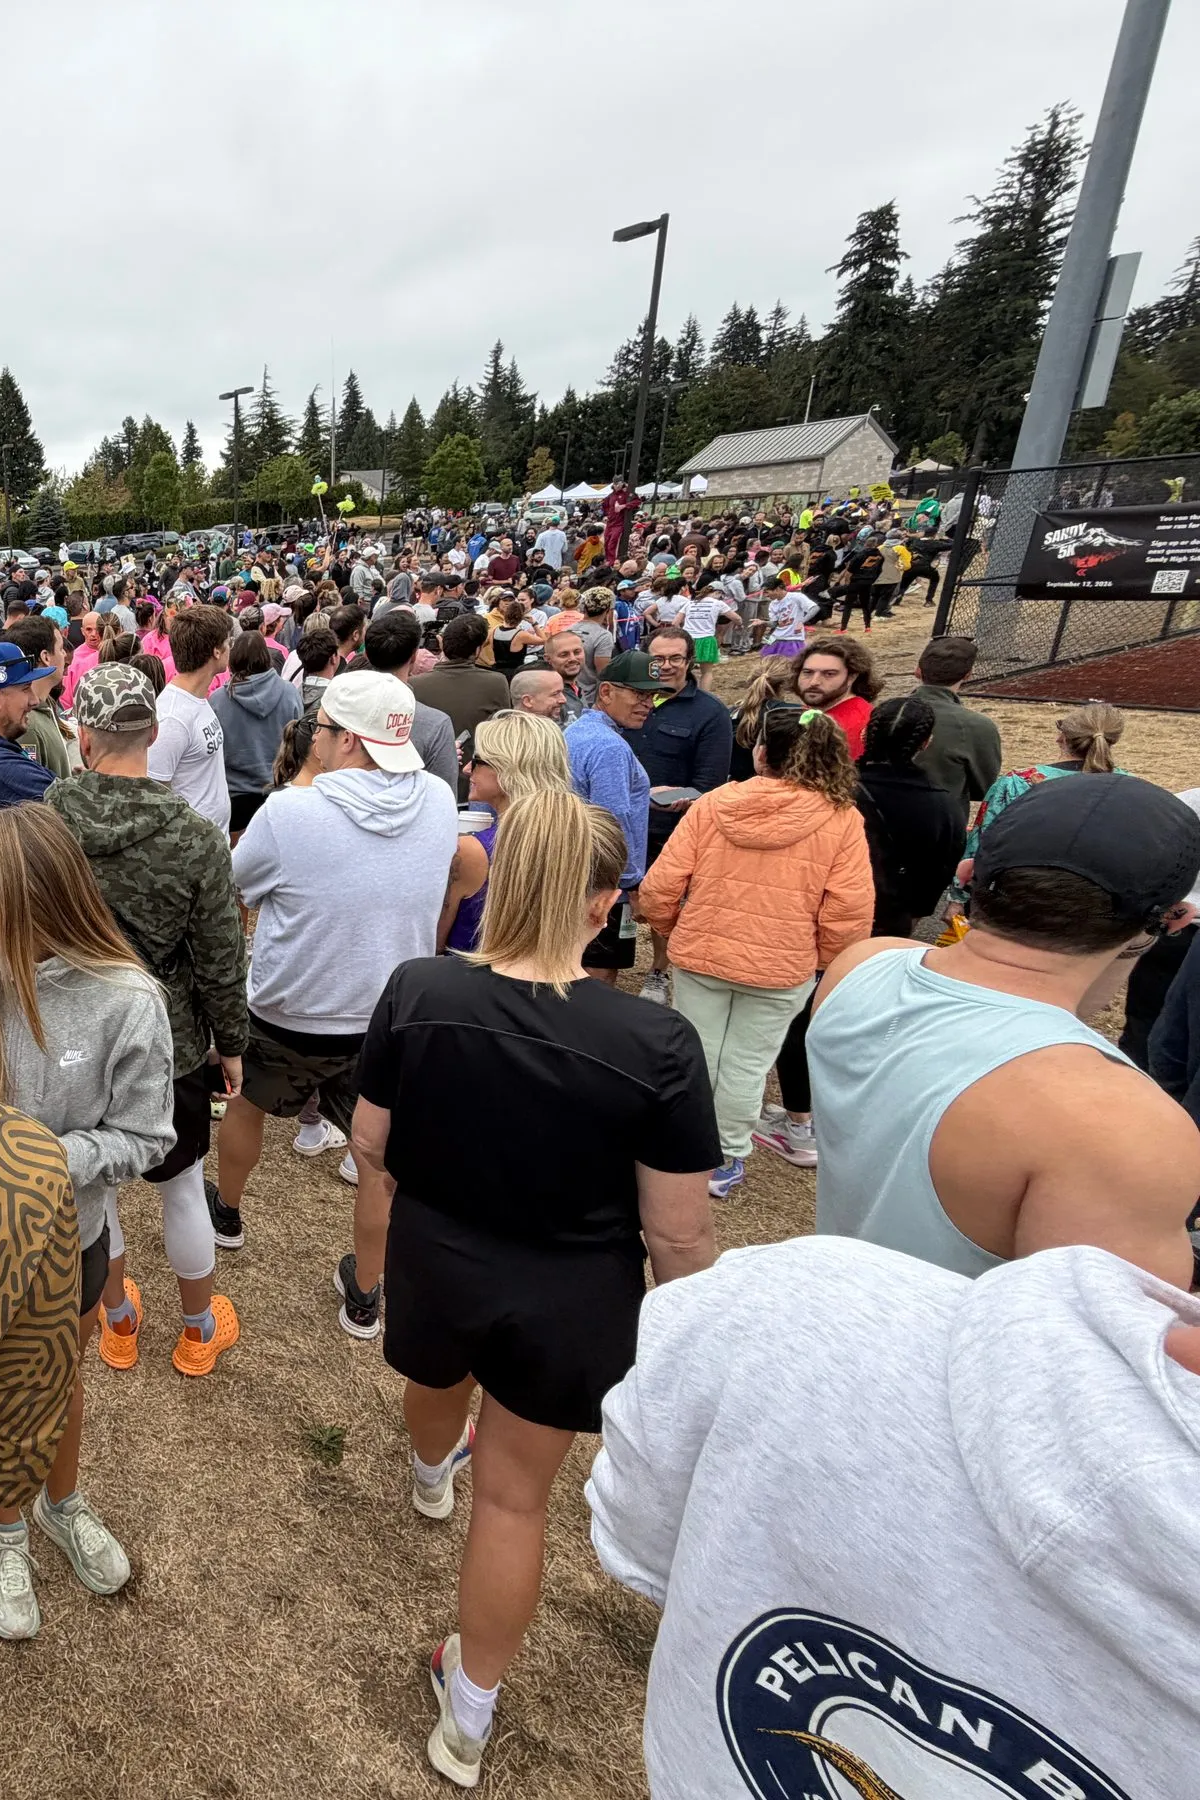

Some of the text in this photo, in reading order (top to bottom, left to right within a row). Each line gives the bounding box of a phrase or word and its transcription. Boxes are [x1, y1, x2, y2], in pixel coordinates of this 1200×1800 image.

[1043, 522, 1087, 545] SANDY
[1057, 544, 1077, 559] 5K
[64, 1049, 85, 1060] NIKE
[755, 1641, 993, 1753] PELICAN
